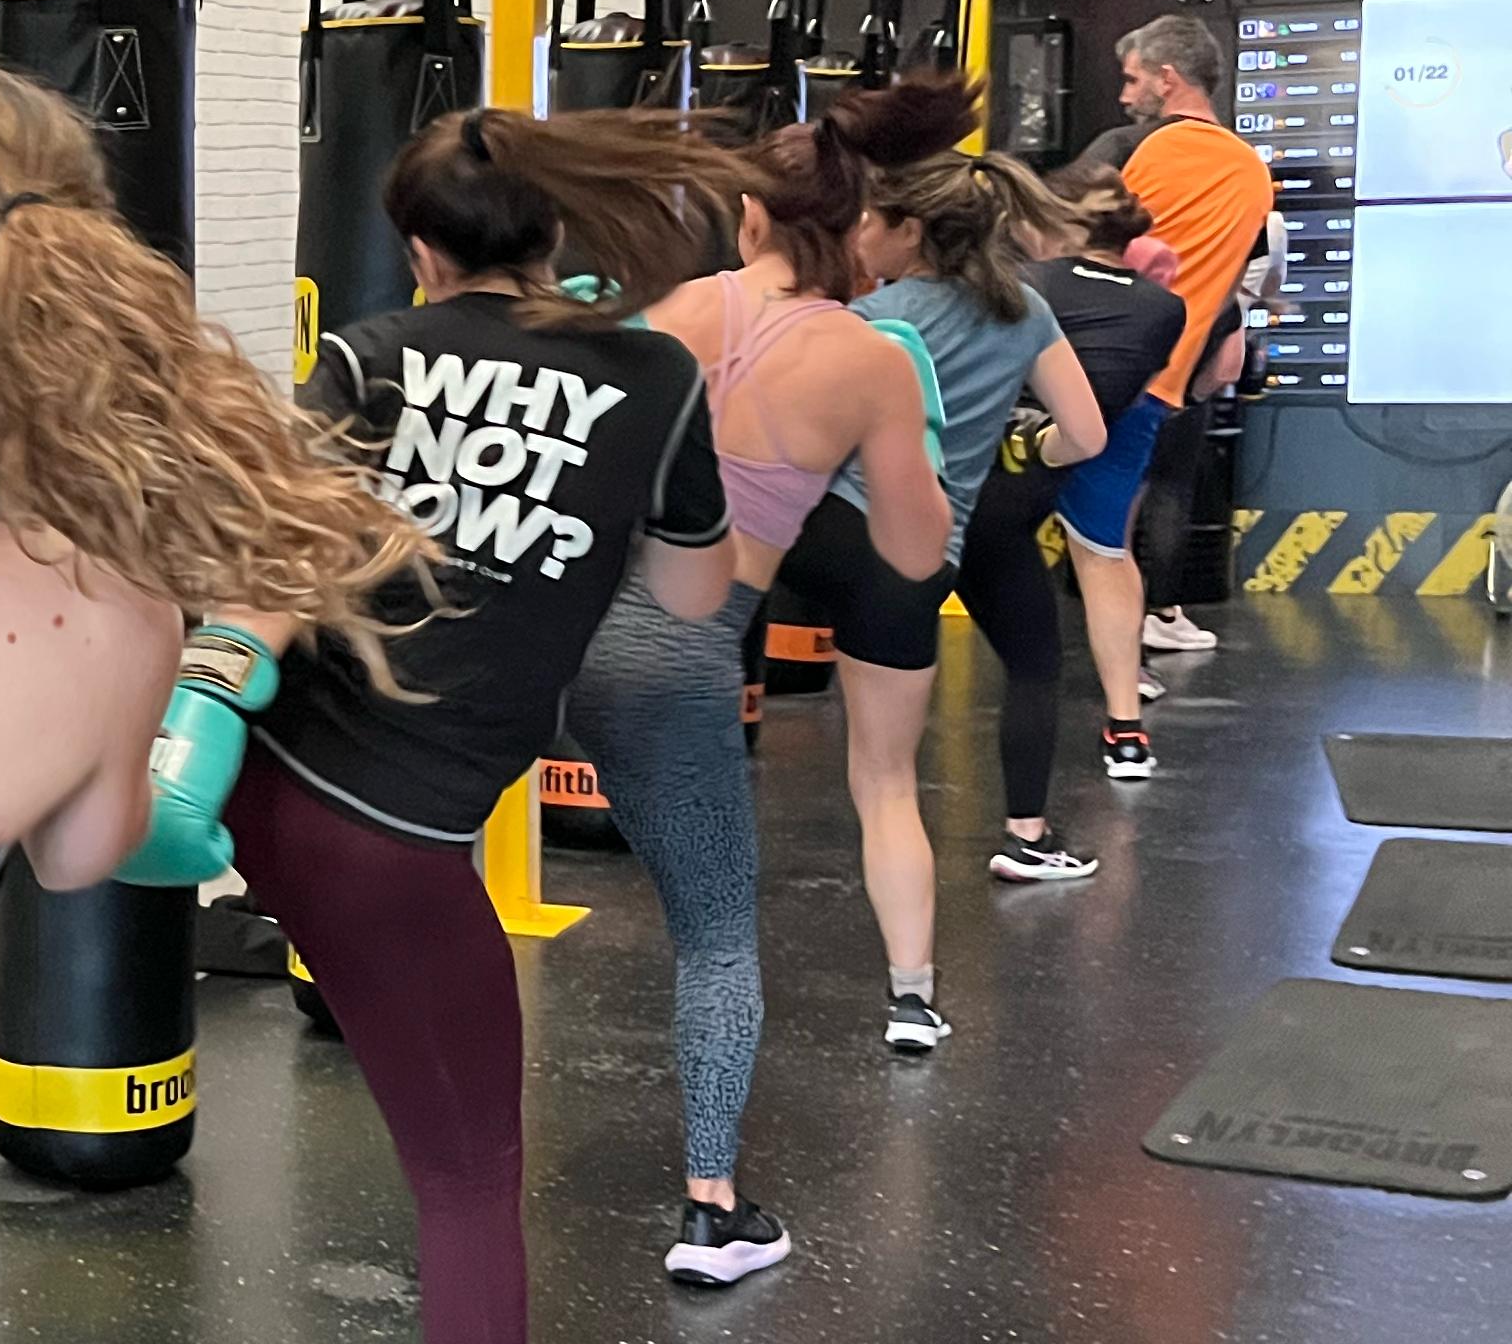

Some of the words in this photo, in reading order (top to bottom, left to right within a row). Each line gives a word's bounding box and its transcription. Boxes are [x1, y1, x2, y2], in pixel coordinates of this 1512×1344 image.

[1393, 64, 1448, 83] 01/22
[402, 346, 628, 443] WHY
[386, 406, 588, 502] NOT
